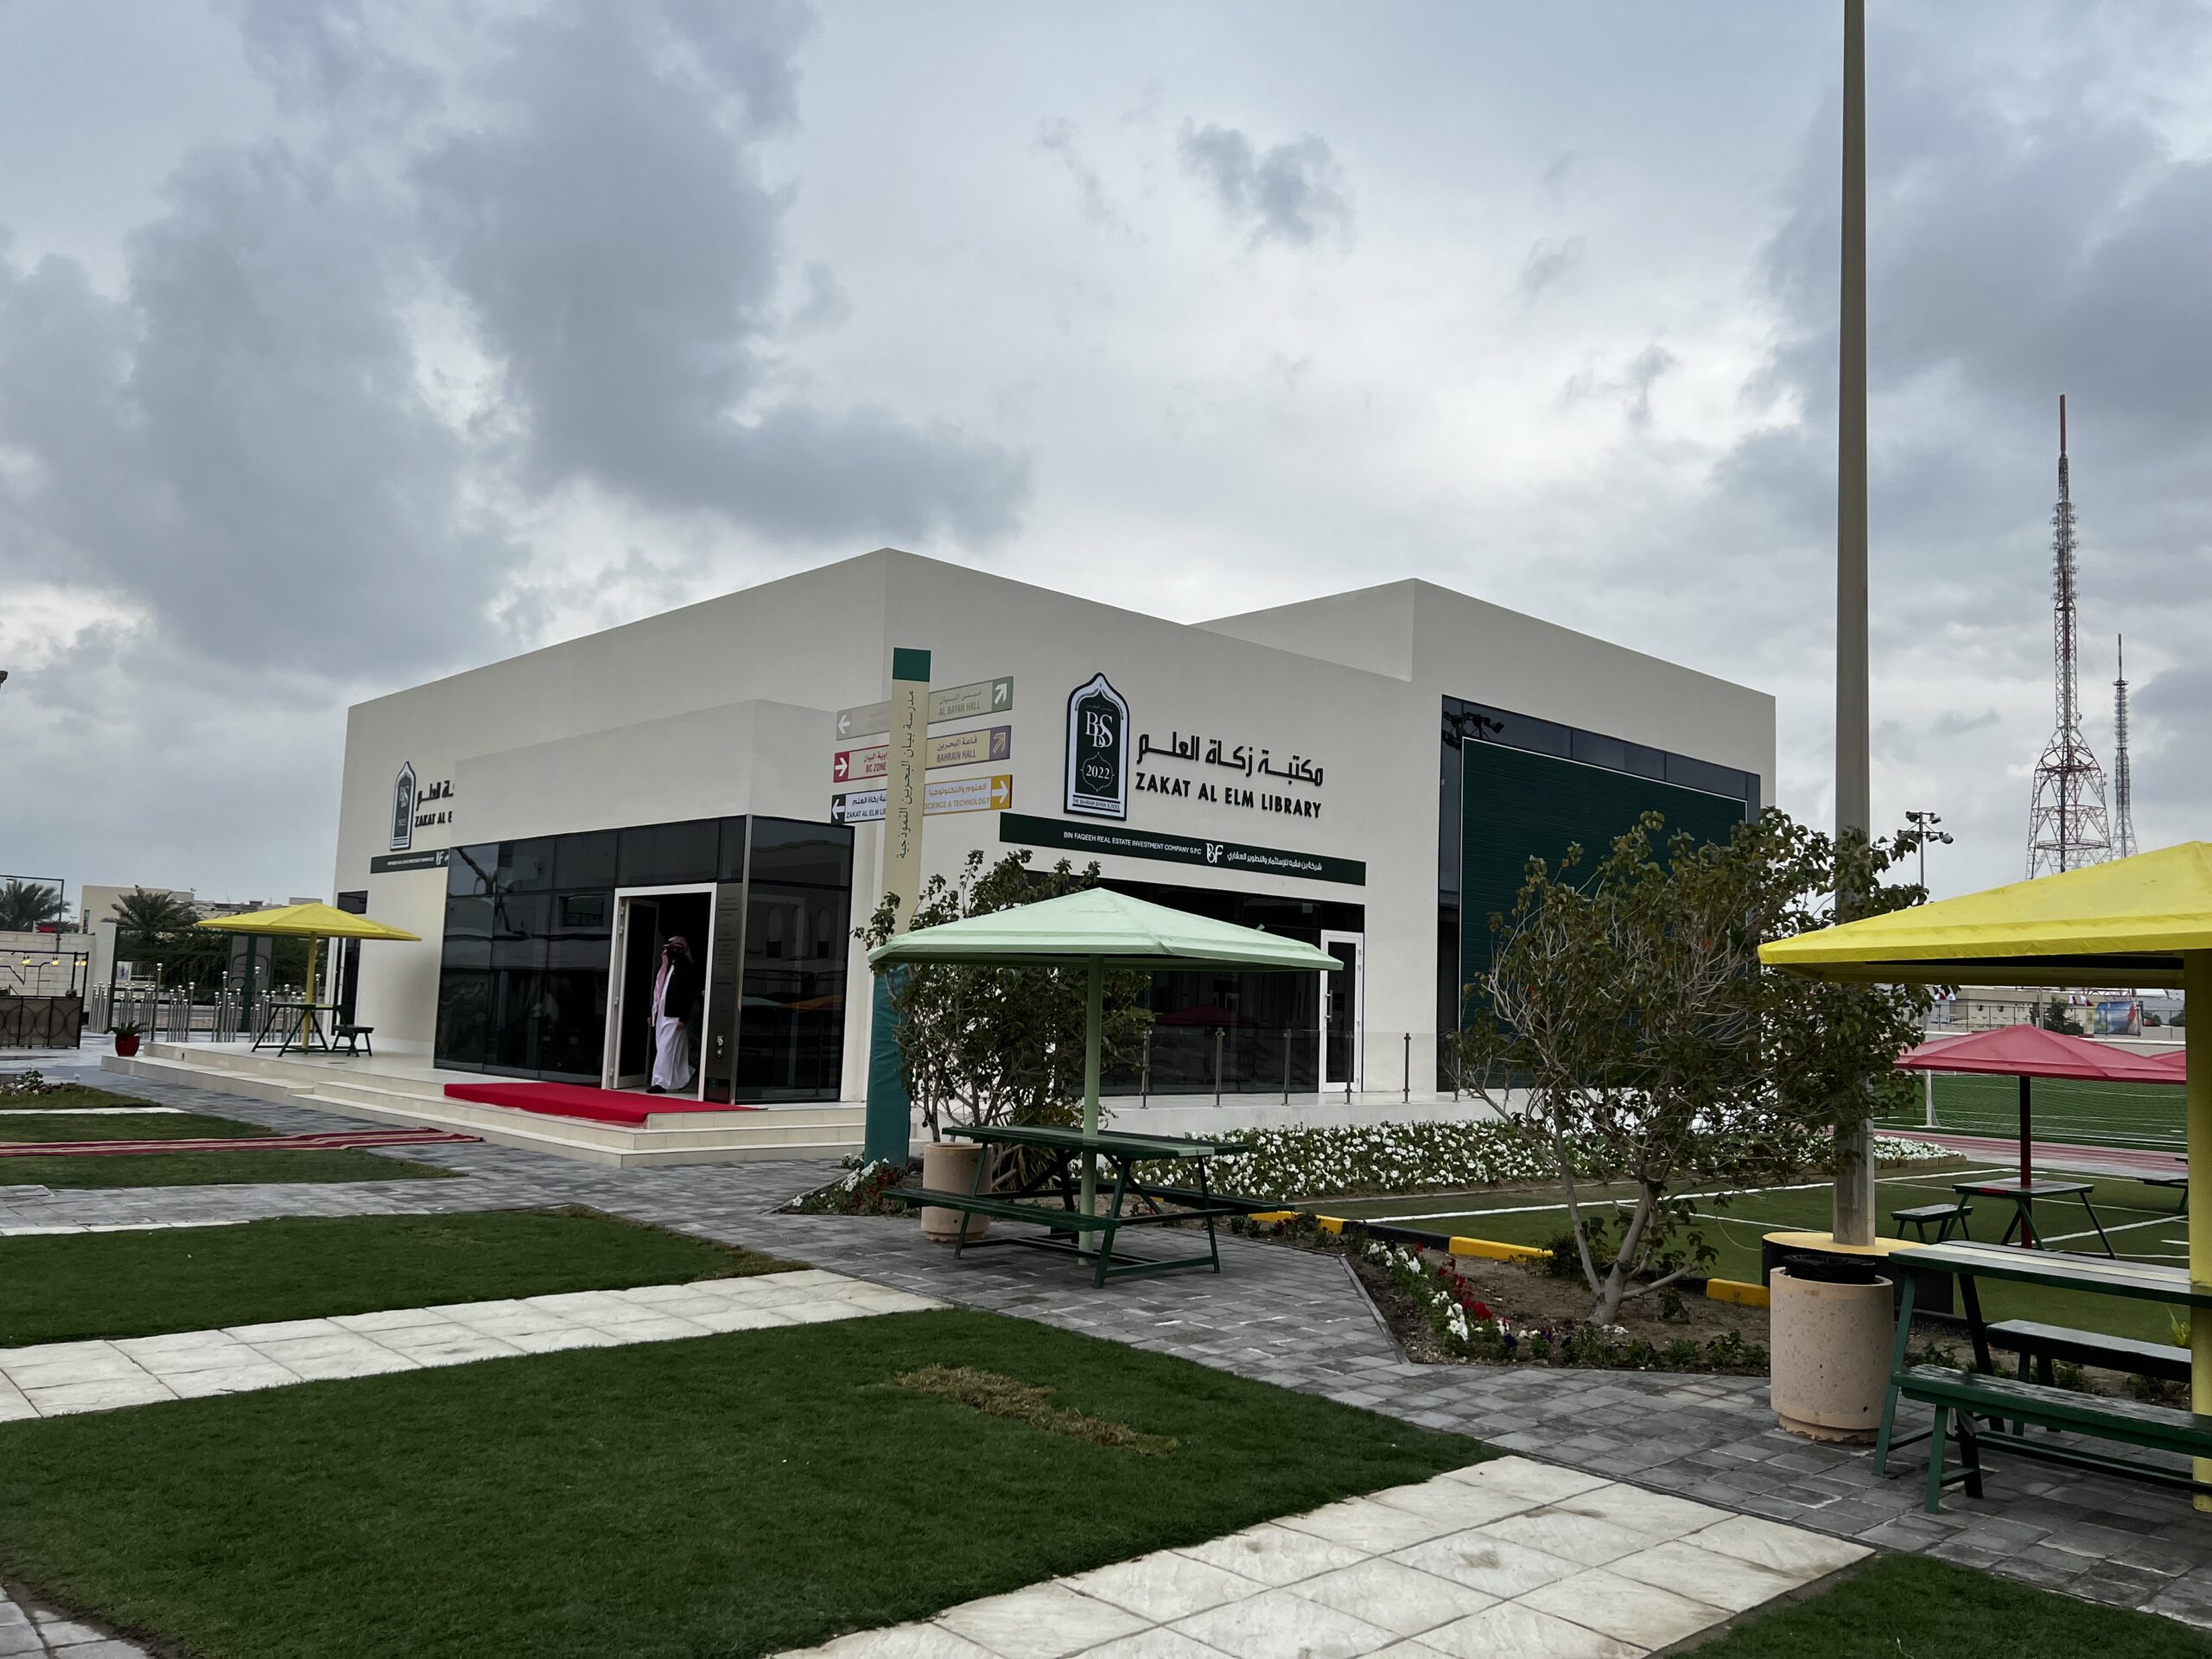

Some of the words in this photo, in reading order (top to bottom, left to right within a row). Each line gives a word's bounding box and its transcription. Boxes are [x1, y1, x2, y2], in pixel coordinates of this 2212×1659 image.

[903, 690, 916, 729] مدرسة
[947, 704, 965, 715] BAYAN
[966, 701, 980, 711] HALL
[901, 733, 915, 757] بيان
[937, 739, 961, 751] البحرين
[962, 735, 977, 745] قاعة
[1136, 731, 1200, 765] العلم
[937, 750, 961, 762] BAHRAIN
[962, 748, 976, 760] HALL
[1205, 739, 1253, 778] زكاة
[874, 762, 887, 772] ZONE
[1086, 765, 1110, 779] 2022
[1257, 749, 1324, 787] مكتبة
[901, 760, 914, 804] البحرين
[925, 800, 947, 810] SCIENCE
[953, 798, 989, 807] TECHNOLOGY
[1135, 772, 1191, 798] ZAKAT
[1198, 783, 1217, 803] AL
[1224, 787, 1254, 808] ELM
[1261, 793, 1322, 819] LIBRARY
[415, 813, 436, 828] ZAKAT
[436, 811, 445, 824] AL
[846, 810, 861, 819] ZAKAT
[869, 808, 880, 817] ELM
[1074, 833, 1096, 842] FAQEEH
[1096, 836, 1111, 844] REAL
[1112, 837, 1132, 846] ESTATE
[1132, 839, 1164, 850] INVESTMENT
[1164, 844, 1189, 853] COMPANY
